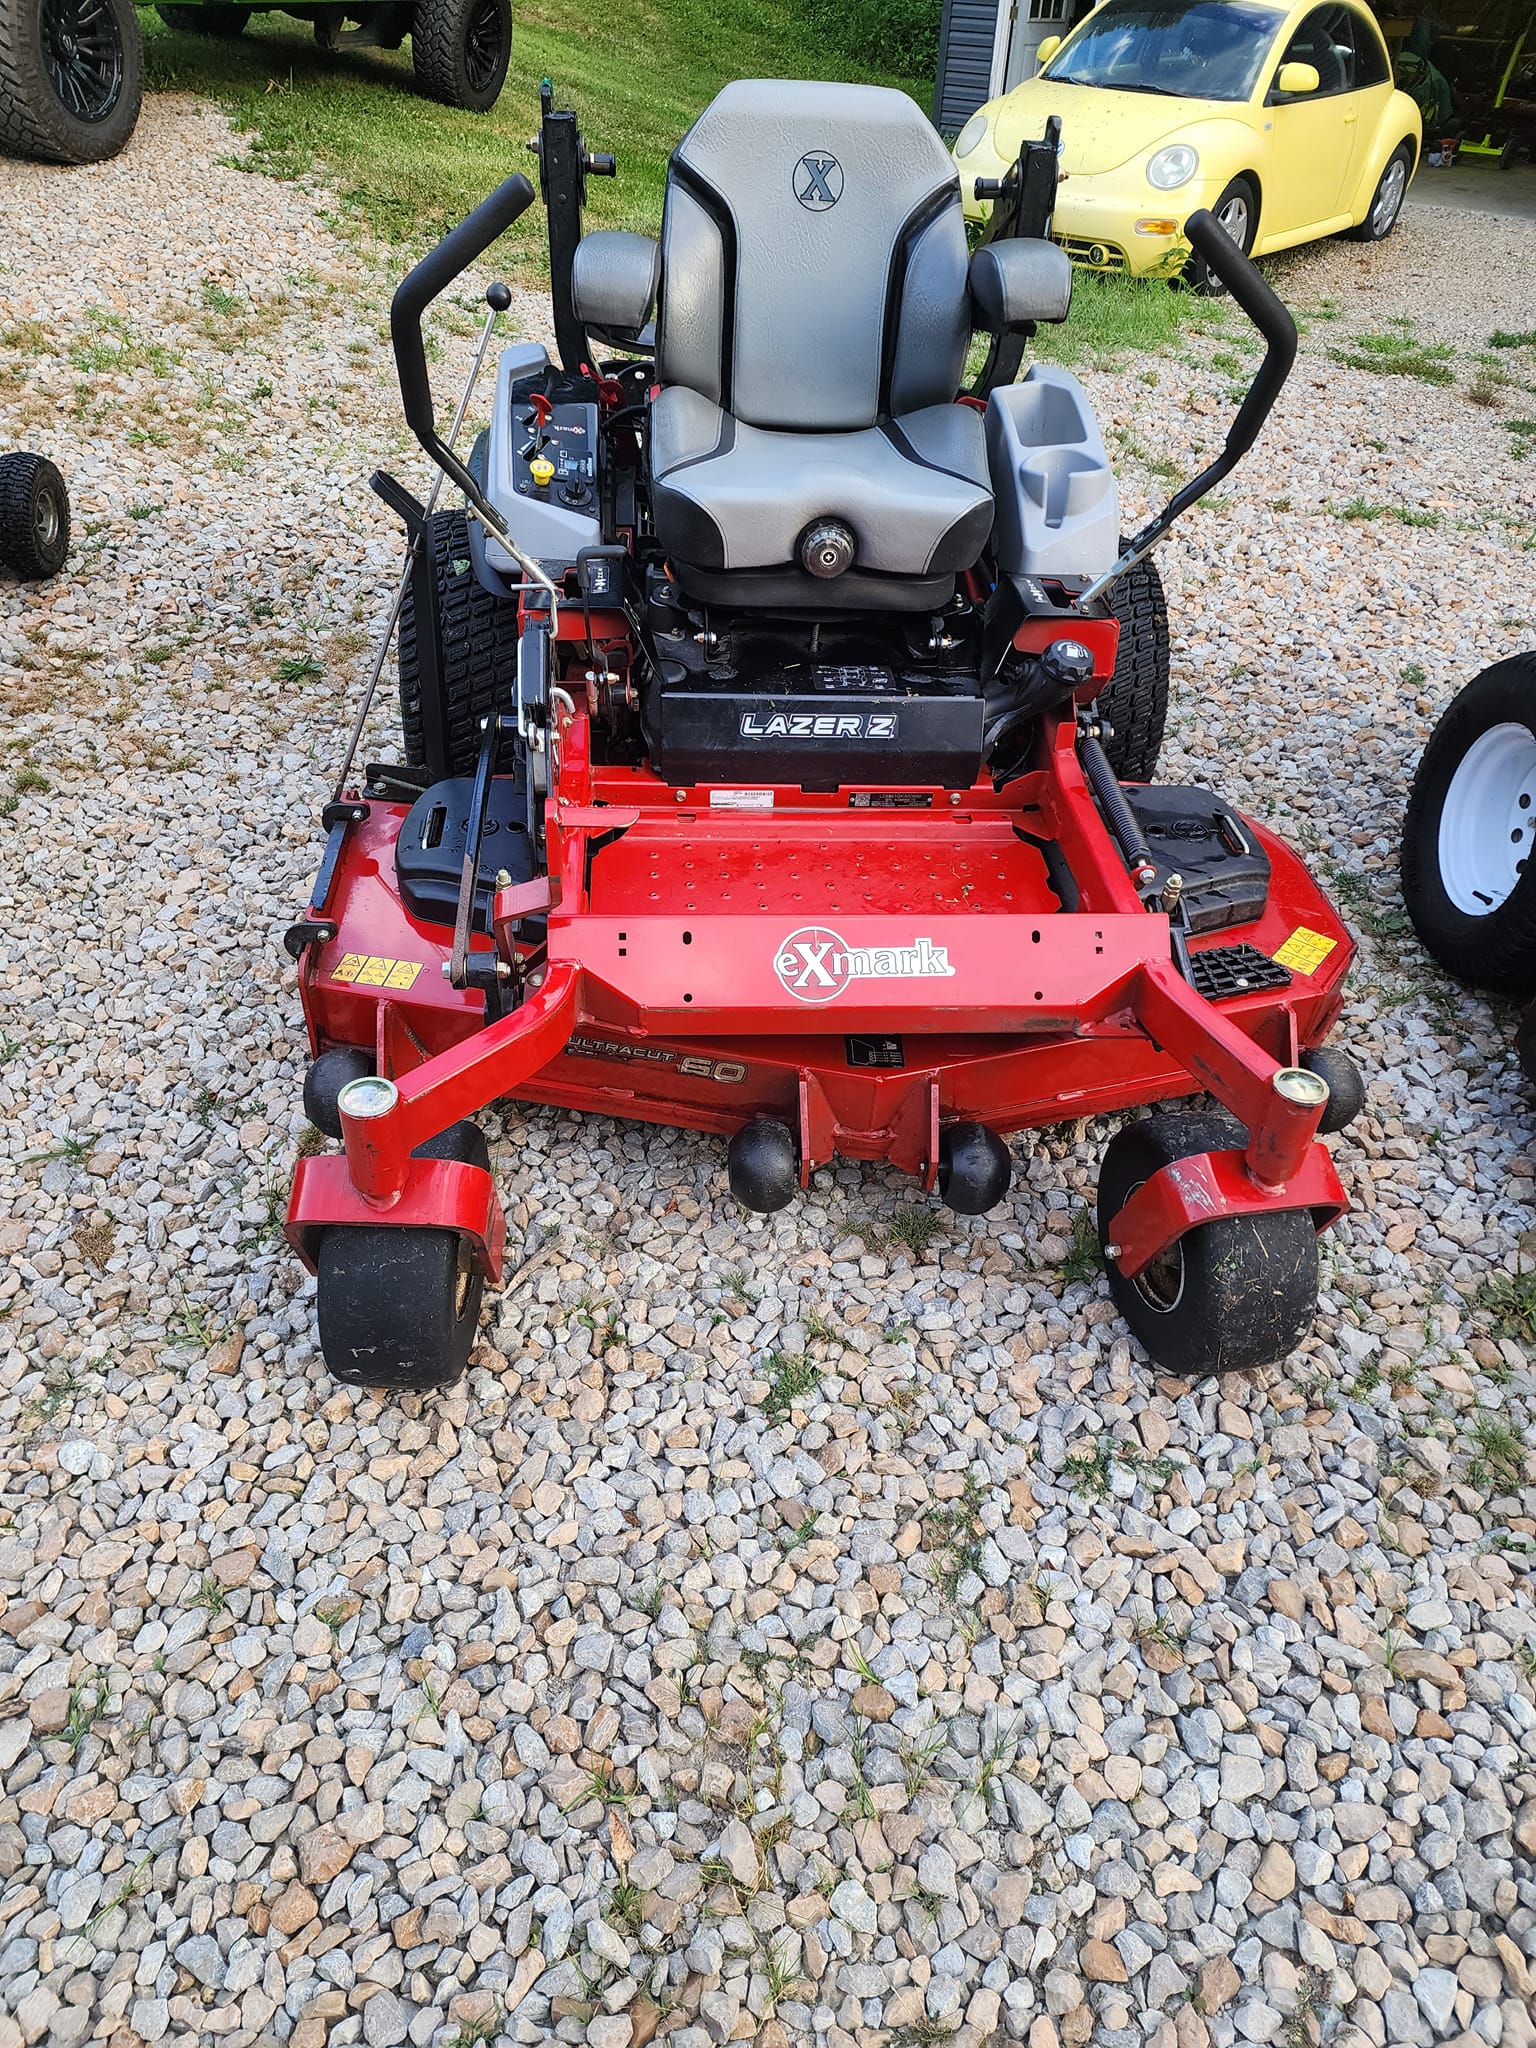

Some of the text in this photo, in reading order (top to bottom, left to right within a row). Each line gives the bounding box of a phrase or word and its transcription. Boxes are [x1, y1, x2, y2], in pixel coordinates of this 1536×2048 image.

[741, 715, 894, 737] LAZER Z
[568, 1036, 747, 1083] ULTRACUT 60
